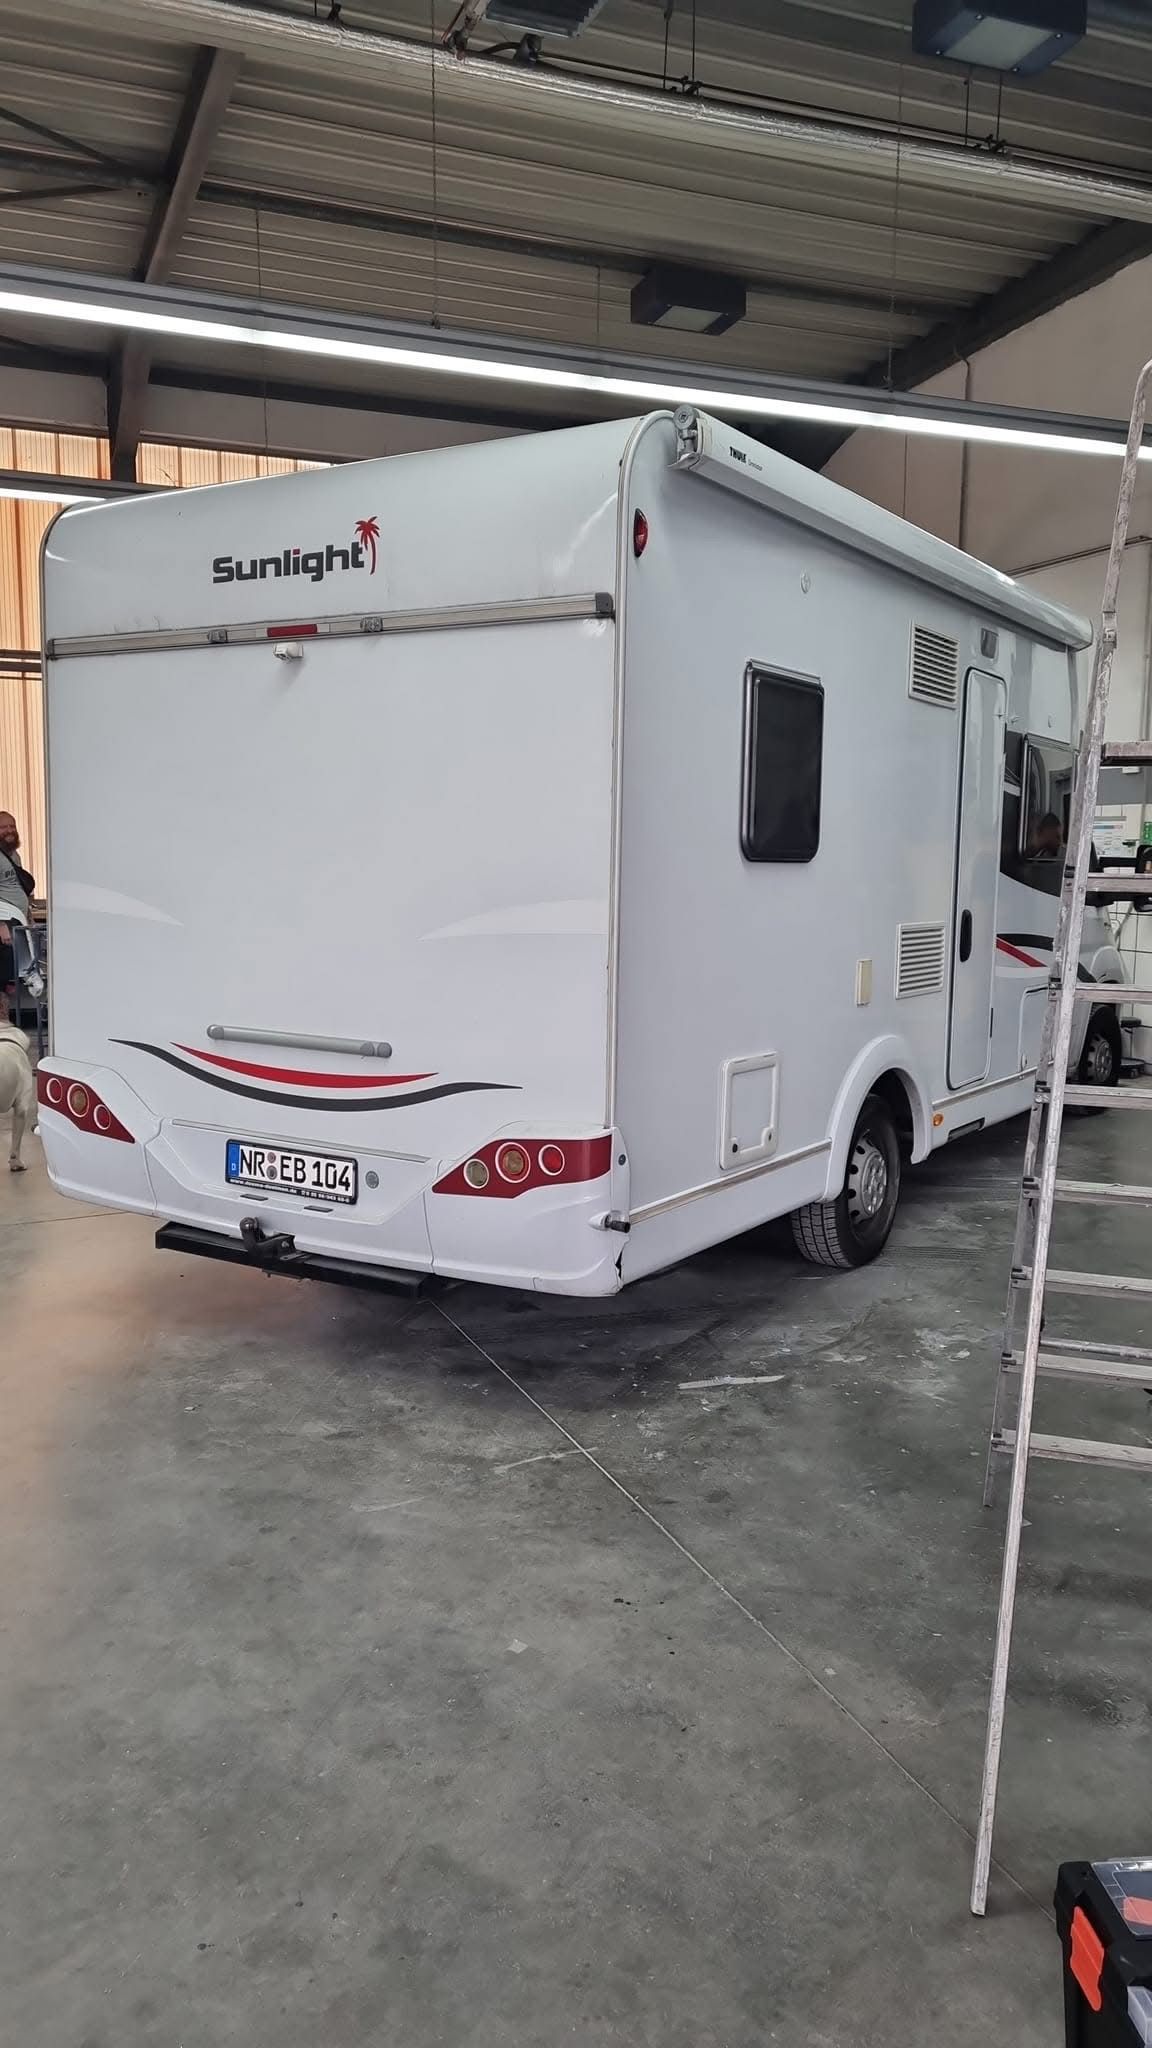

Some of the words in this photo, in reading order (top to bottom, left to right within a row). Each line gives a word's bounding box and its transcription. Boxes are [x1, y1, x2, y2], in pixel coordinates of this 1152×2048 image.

[212, 541, 365, 584] Sunlight
[240, 1148, 265, 1177] NR
[280, 1155, 306, 1183] EB
[311, 1160, 351, 1191] 104
